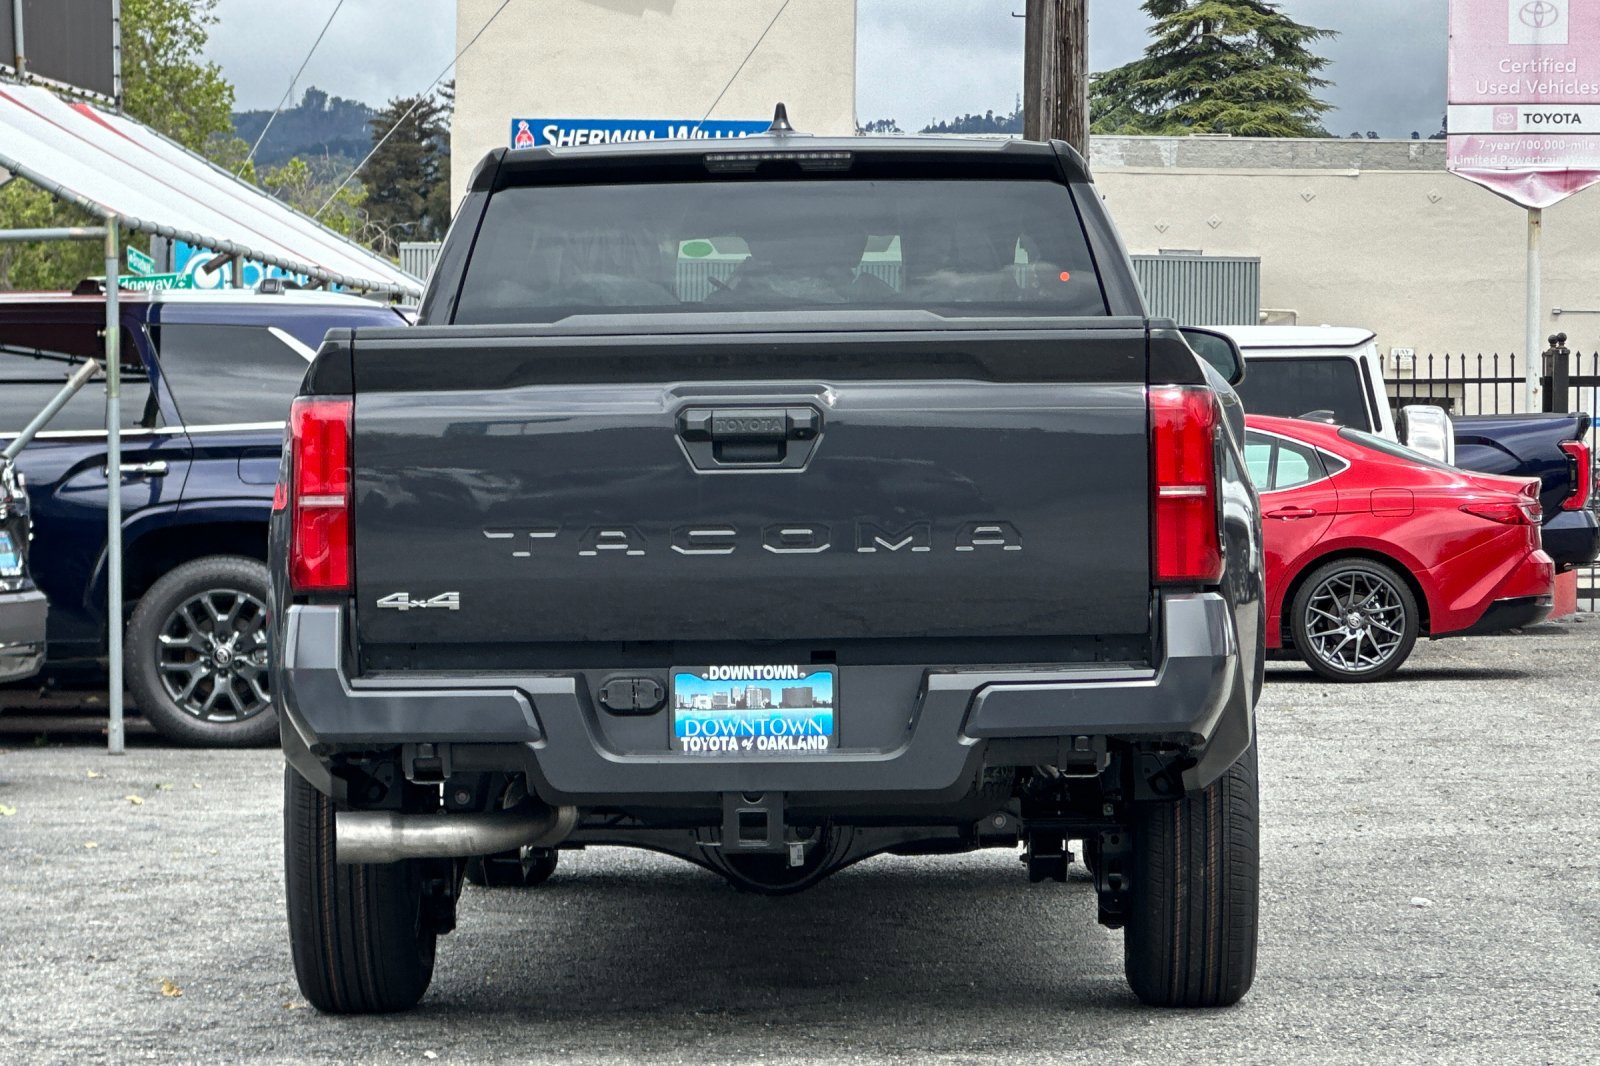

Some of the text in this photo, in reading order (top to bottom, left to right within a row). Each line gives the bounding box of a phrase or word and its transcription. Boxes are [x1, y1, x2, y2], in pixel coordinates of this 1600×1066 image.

[1499, 58, 1577, 74] Certified
[1476, 79, 1600, 95] Used Vehicles
[1523, 113, 1582, 124] TOYOTA
[1454, 155, 1497, 165] Limited
[716, 419, 783, 432] TOYOTA
[483, 521, 1023, 557] TACOMA
[709, 665, 798, 680] DOWNTOWN
[685, 719, 823, 736] DOWNTOWN
[681, 736, 829, 751] TOYOTA of OAKLAND
